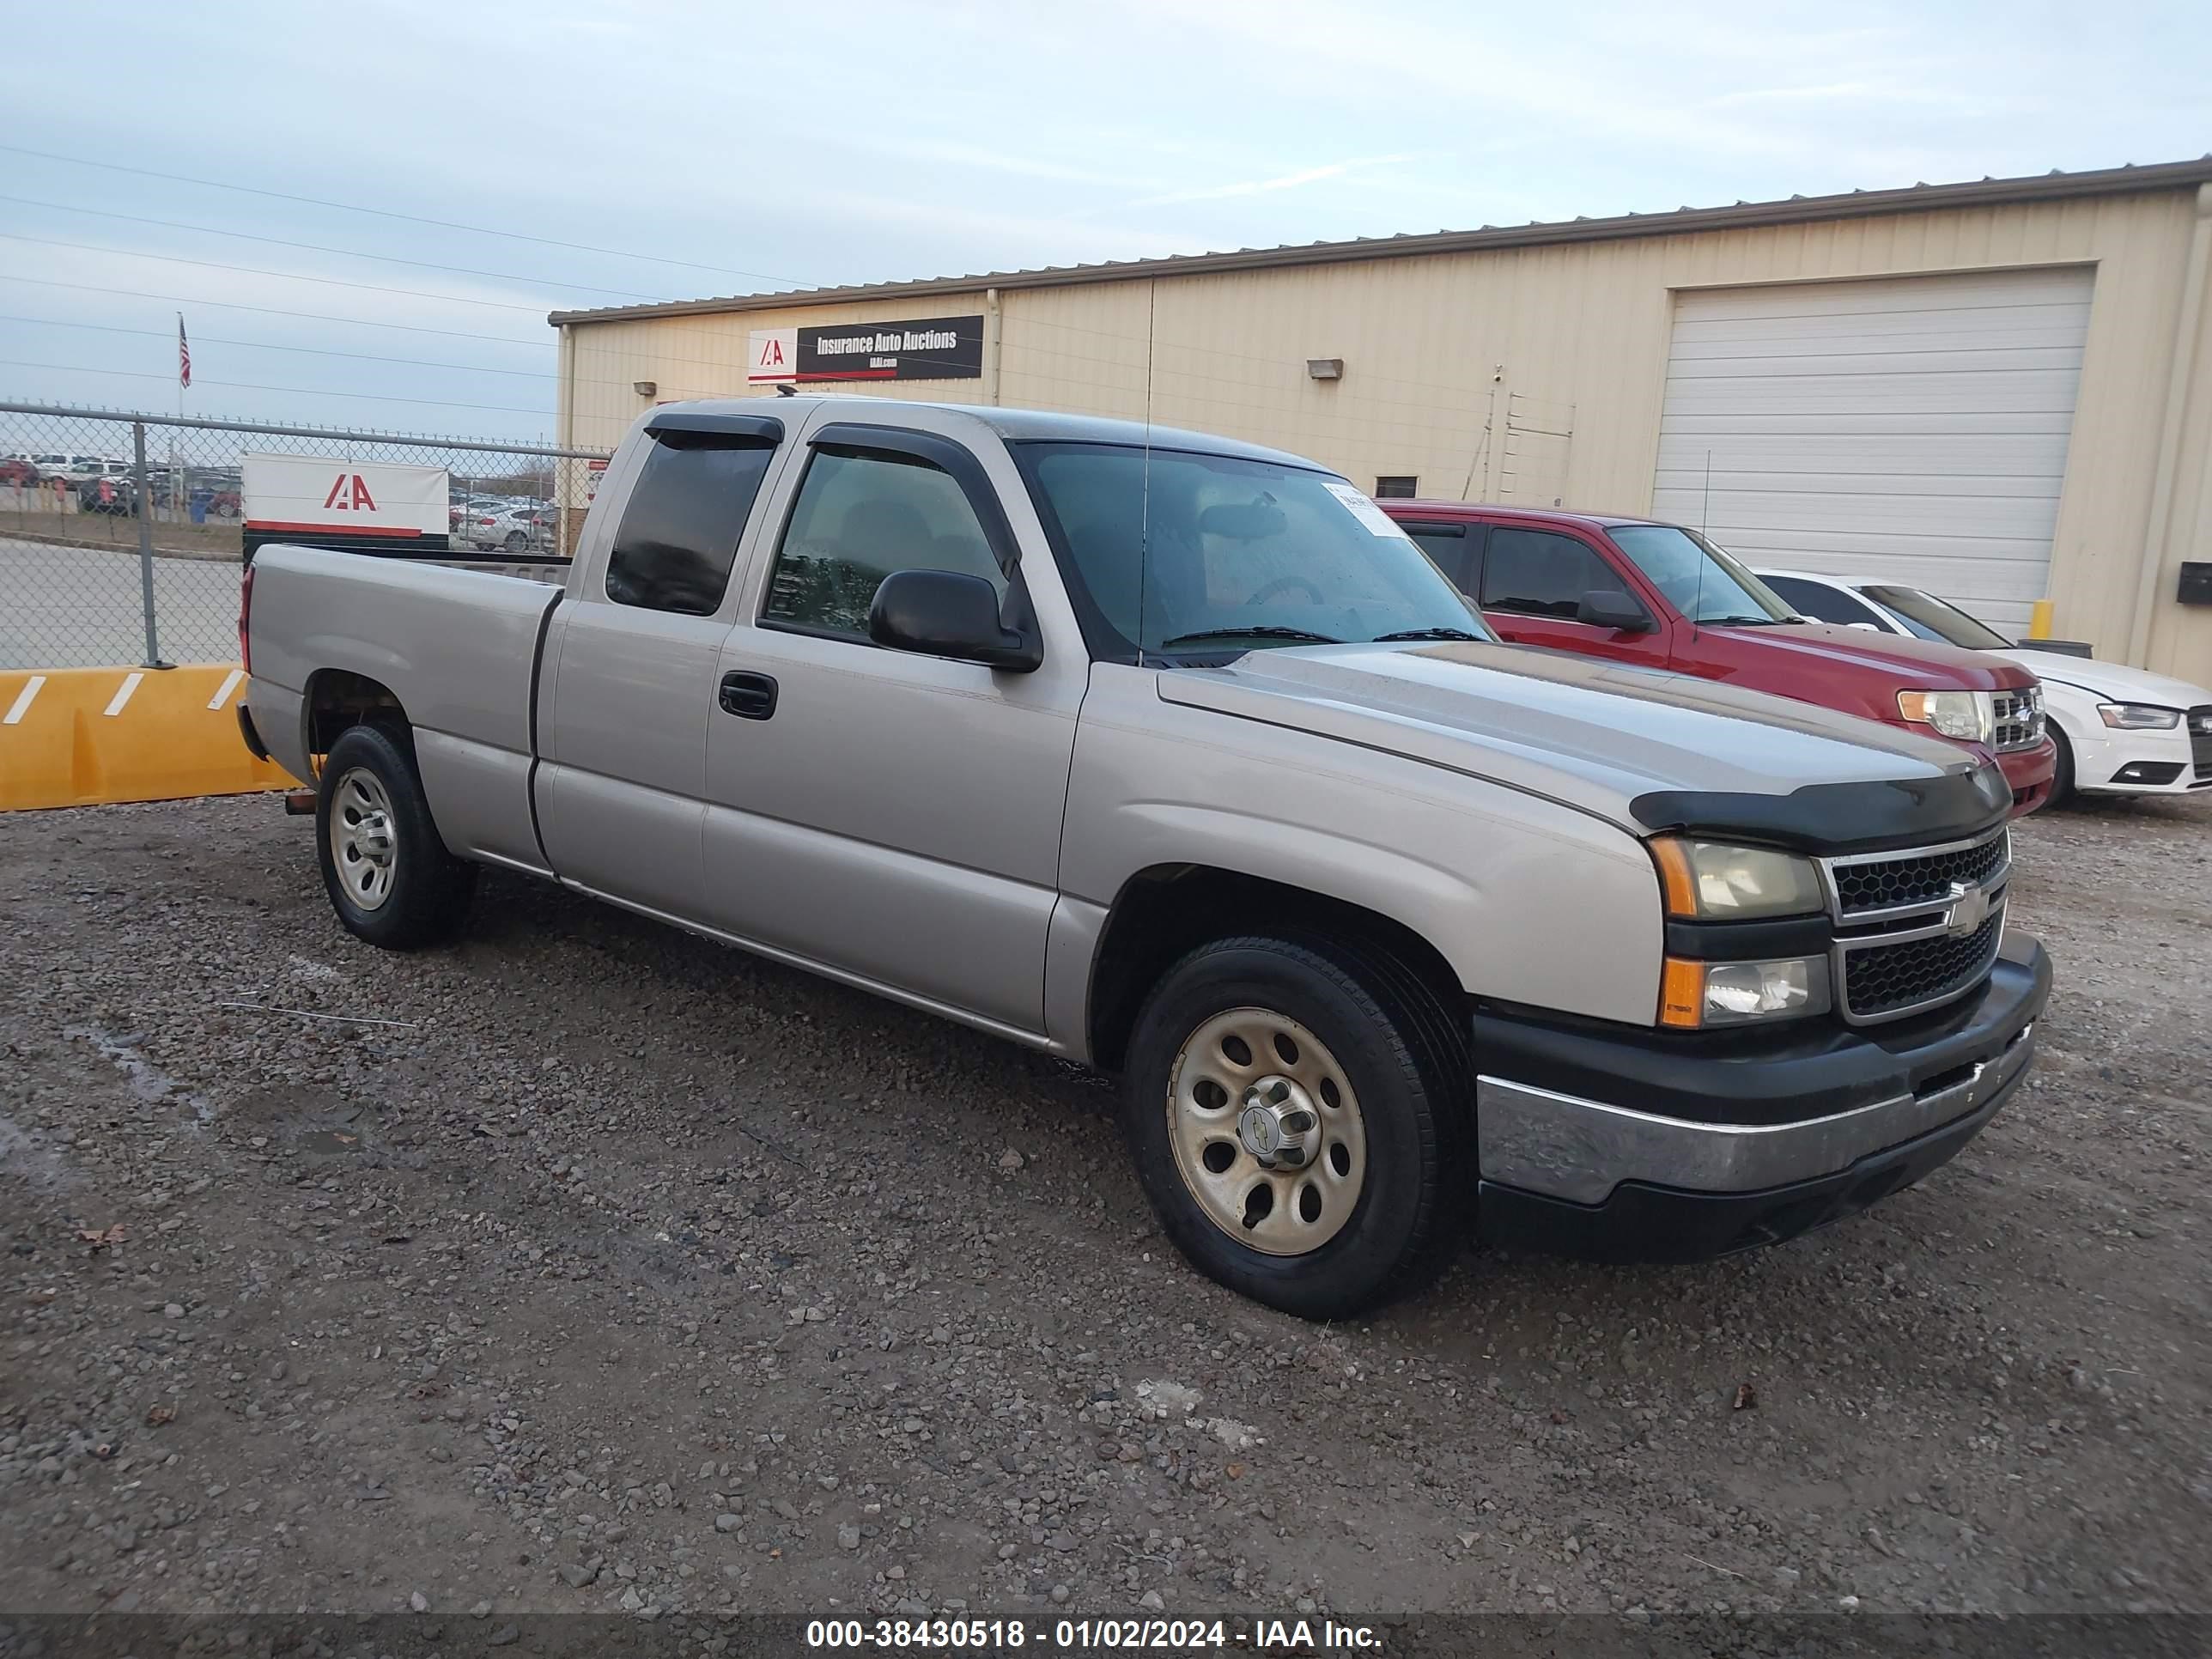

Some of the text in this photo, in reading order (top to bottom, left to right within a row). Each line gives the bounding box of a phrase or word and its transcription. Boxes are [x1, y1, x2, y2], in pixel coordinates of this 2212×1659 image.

[817, 330, 957, 355] Insurance Auto Auctions
